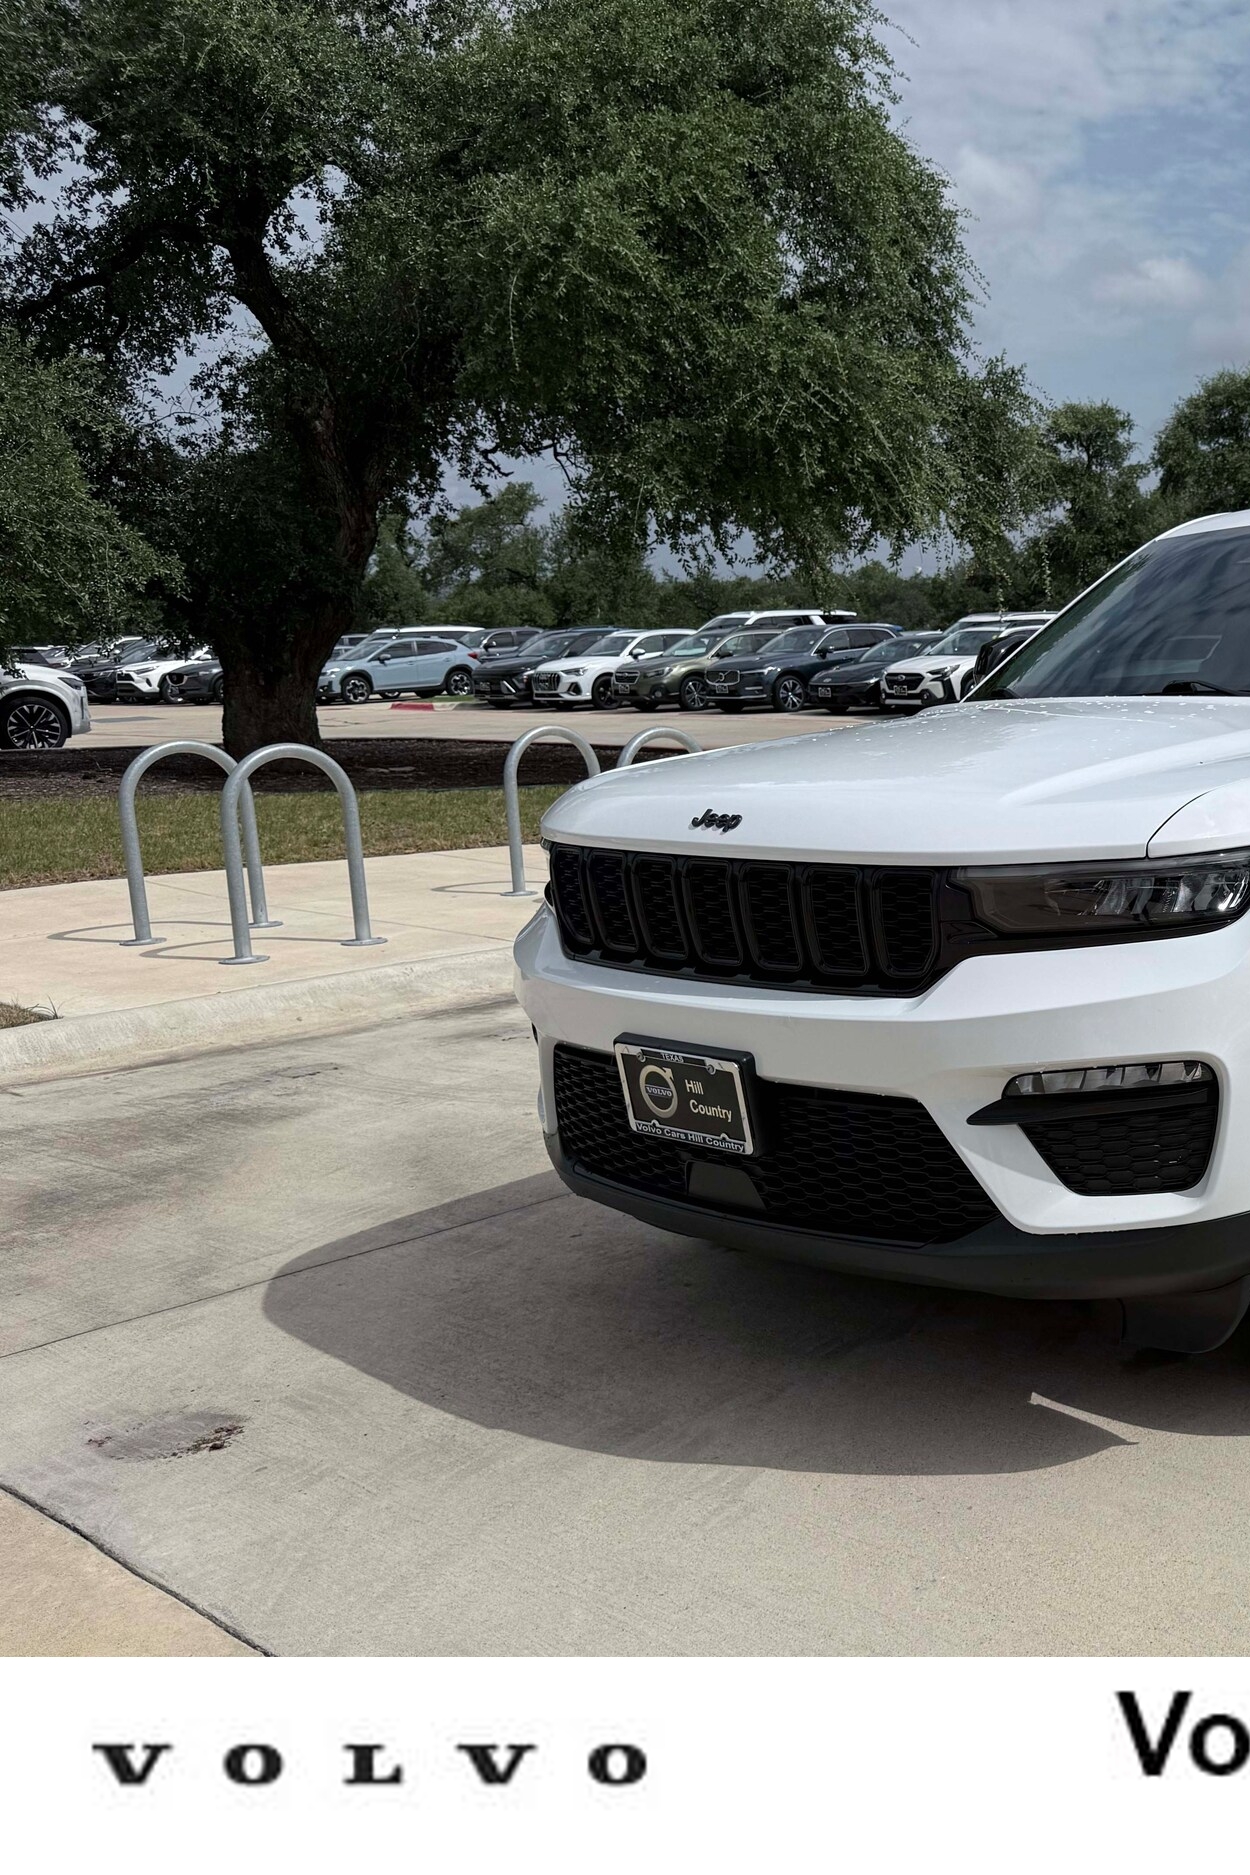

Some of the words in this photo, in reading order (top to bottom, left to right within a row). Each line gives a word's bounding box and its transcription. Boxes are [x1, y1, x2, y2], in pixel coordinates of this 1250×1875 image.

[691, 808, 743, 833] Jeep
[661, 1052, 685, 1063] TEXAS
[646, 1086, 672, 1097] VOLVO
[685, 1079, 704, 1095] Hill
[689, 1100, 732, 1122] Country
[636, 1123, 662, 1135] Volvo
[663, 1128, 686, 1140] Cars
[688, 1134, 704, 1144] Hill
[705, 1136, 745, 1153] Country
